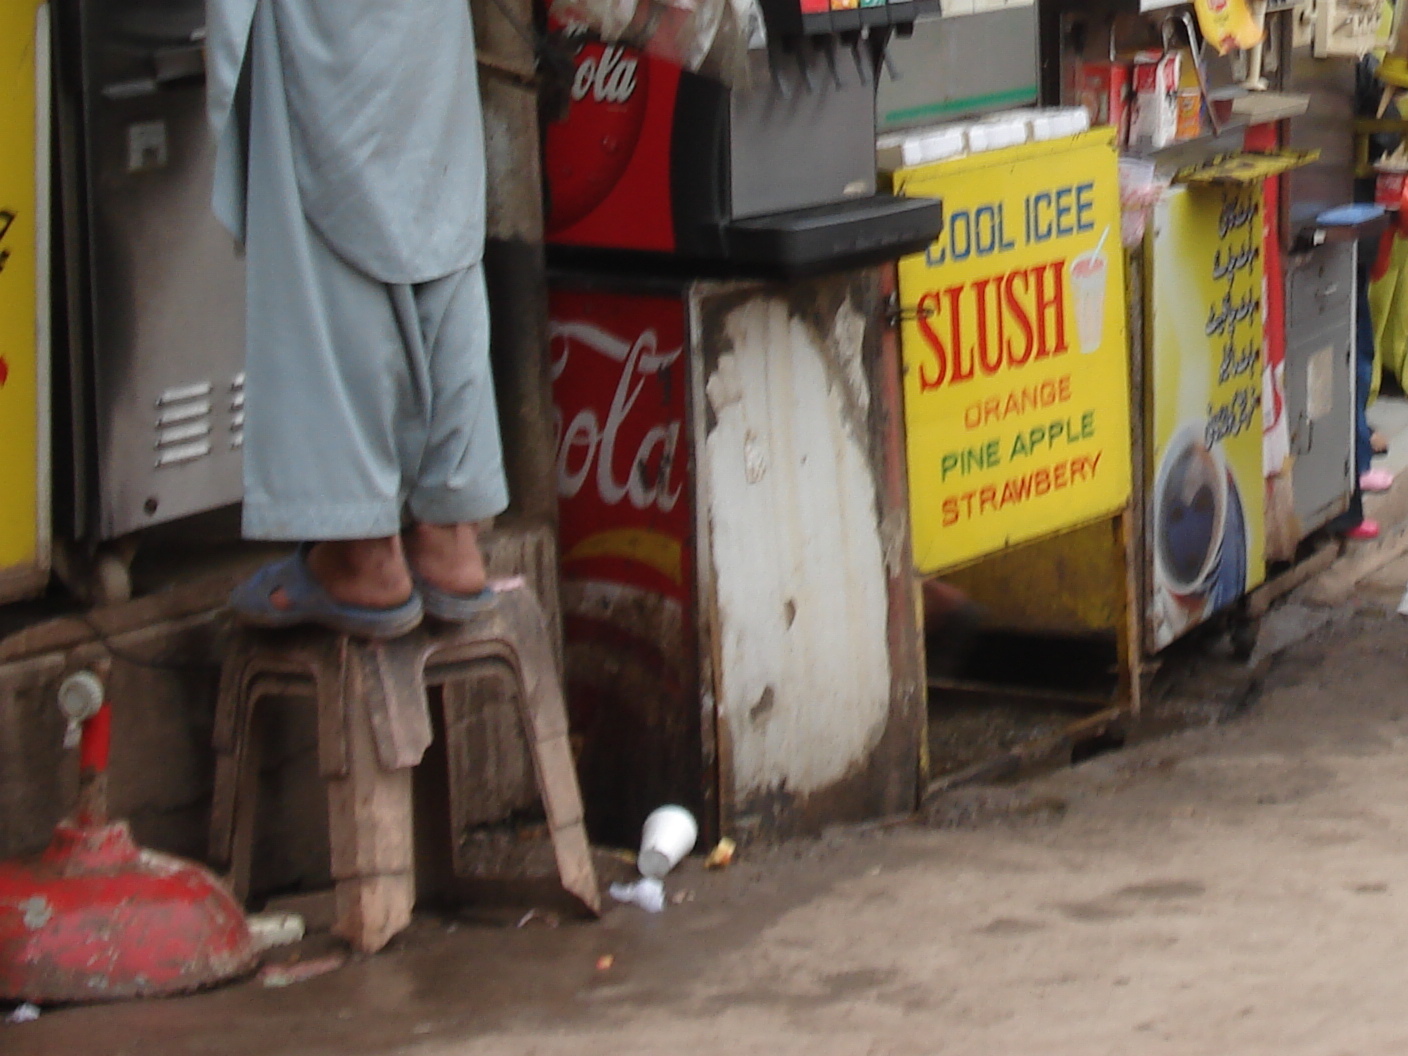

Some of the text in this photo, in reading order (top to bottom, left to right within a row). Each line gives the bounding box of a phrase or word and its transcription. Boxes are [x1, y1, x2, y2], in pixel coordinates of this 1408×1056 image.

[571, 42, 640, 104] ola
[1023, 181, 1096, 246] ICEE
[917, 257, 1069, 396] SLUSH
[551, 320, 683, 513] ola
[964, 373, 1073, 432] ORANGE
[940, 408, 1096, 484] PINE APPLE
[940, 450, 1103, 529] STRAWBERY
